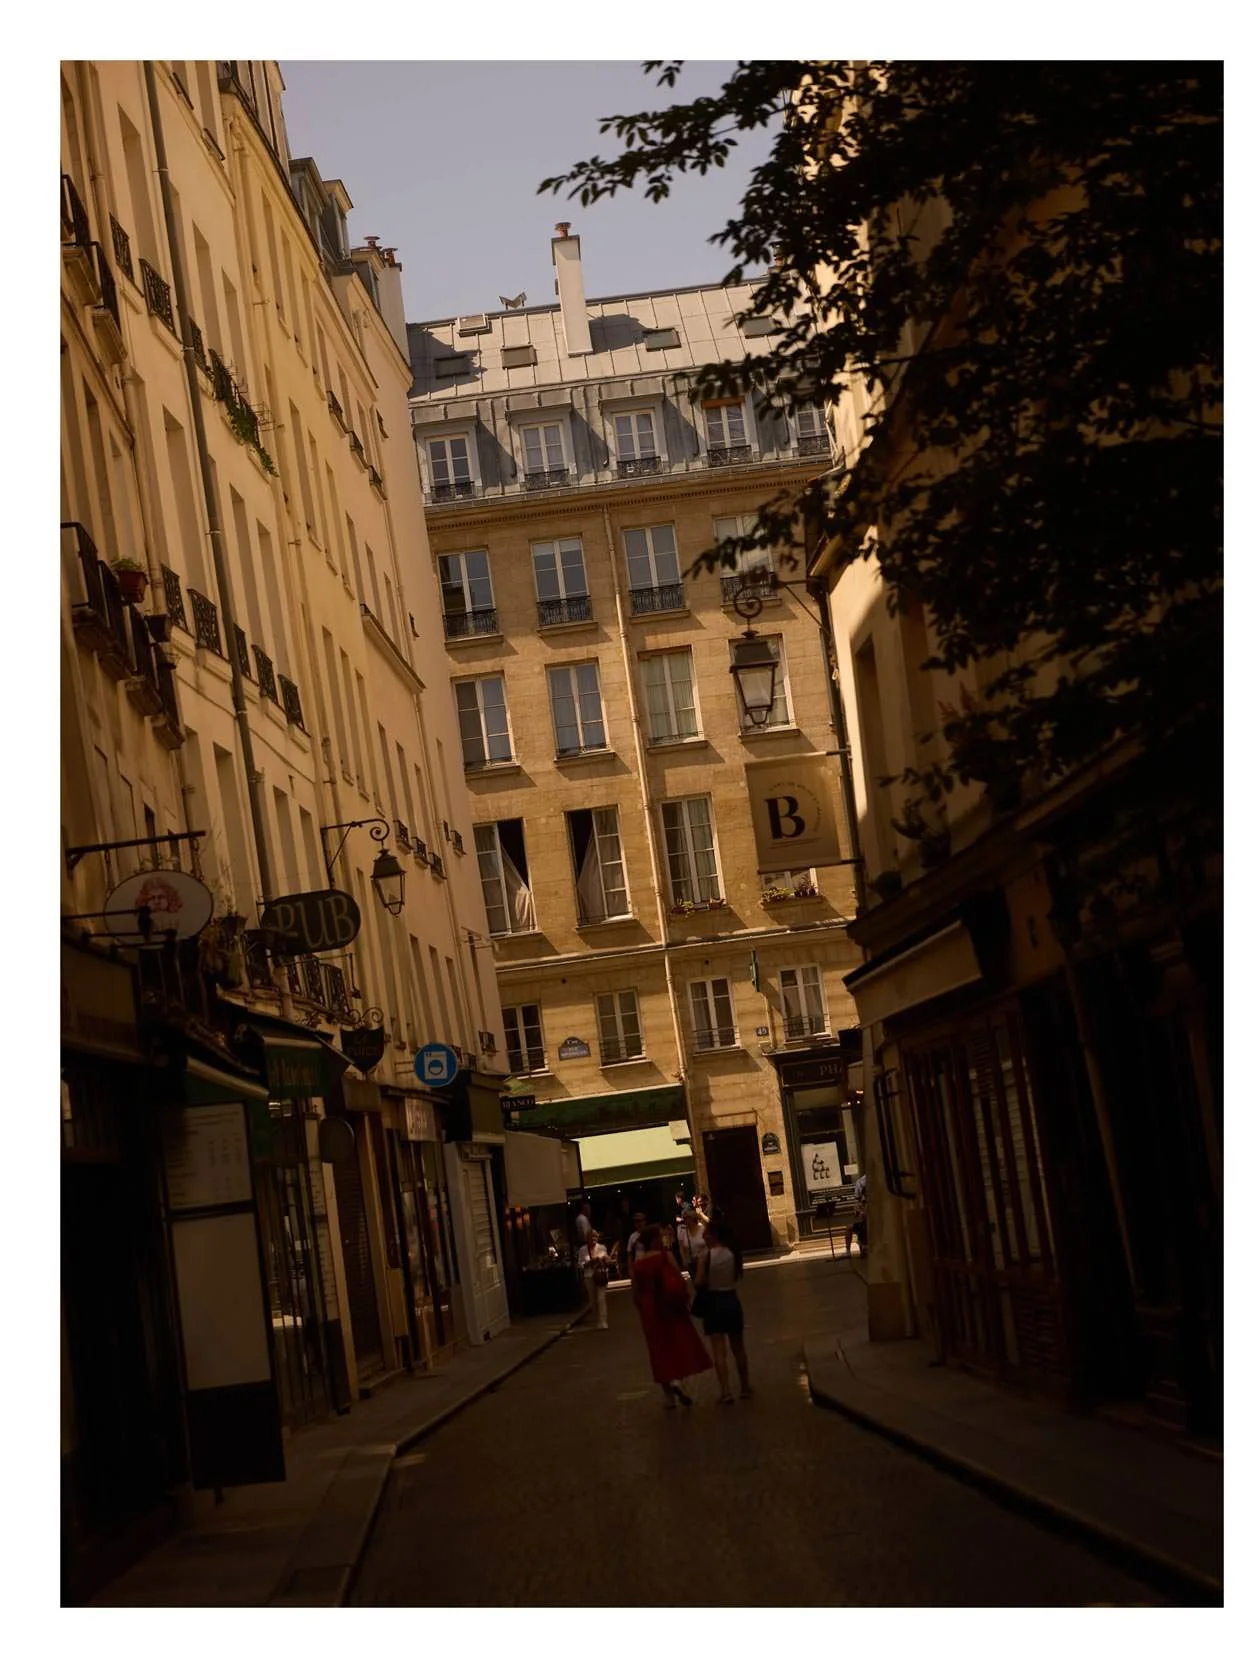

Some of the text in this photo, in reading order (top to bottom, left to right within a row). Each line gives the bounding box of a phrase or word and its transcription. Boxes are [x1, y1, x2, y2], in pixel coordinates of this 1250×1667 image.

[764, 796, 805, 839] B
[271, 894, 355, 948] PUB
[818, 1062, 842, 1077] PH
